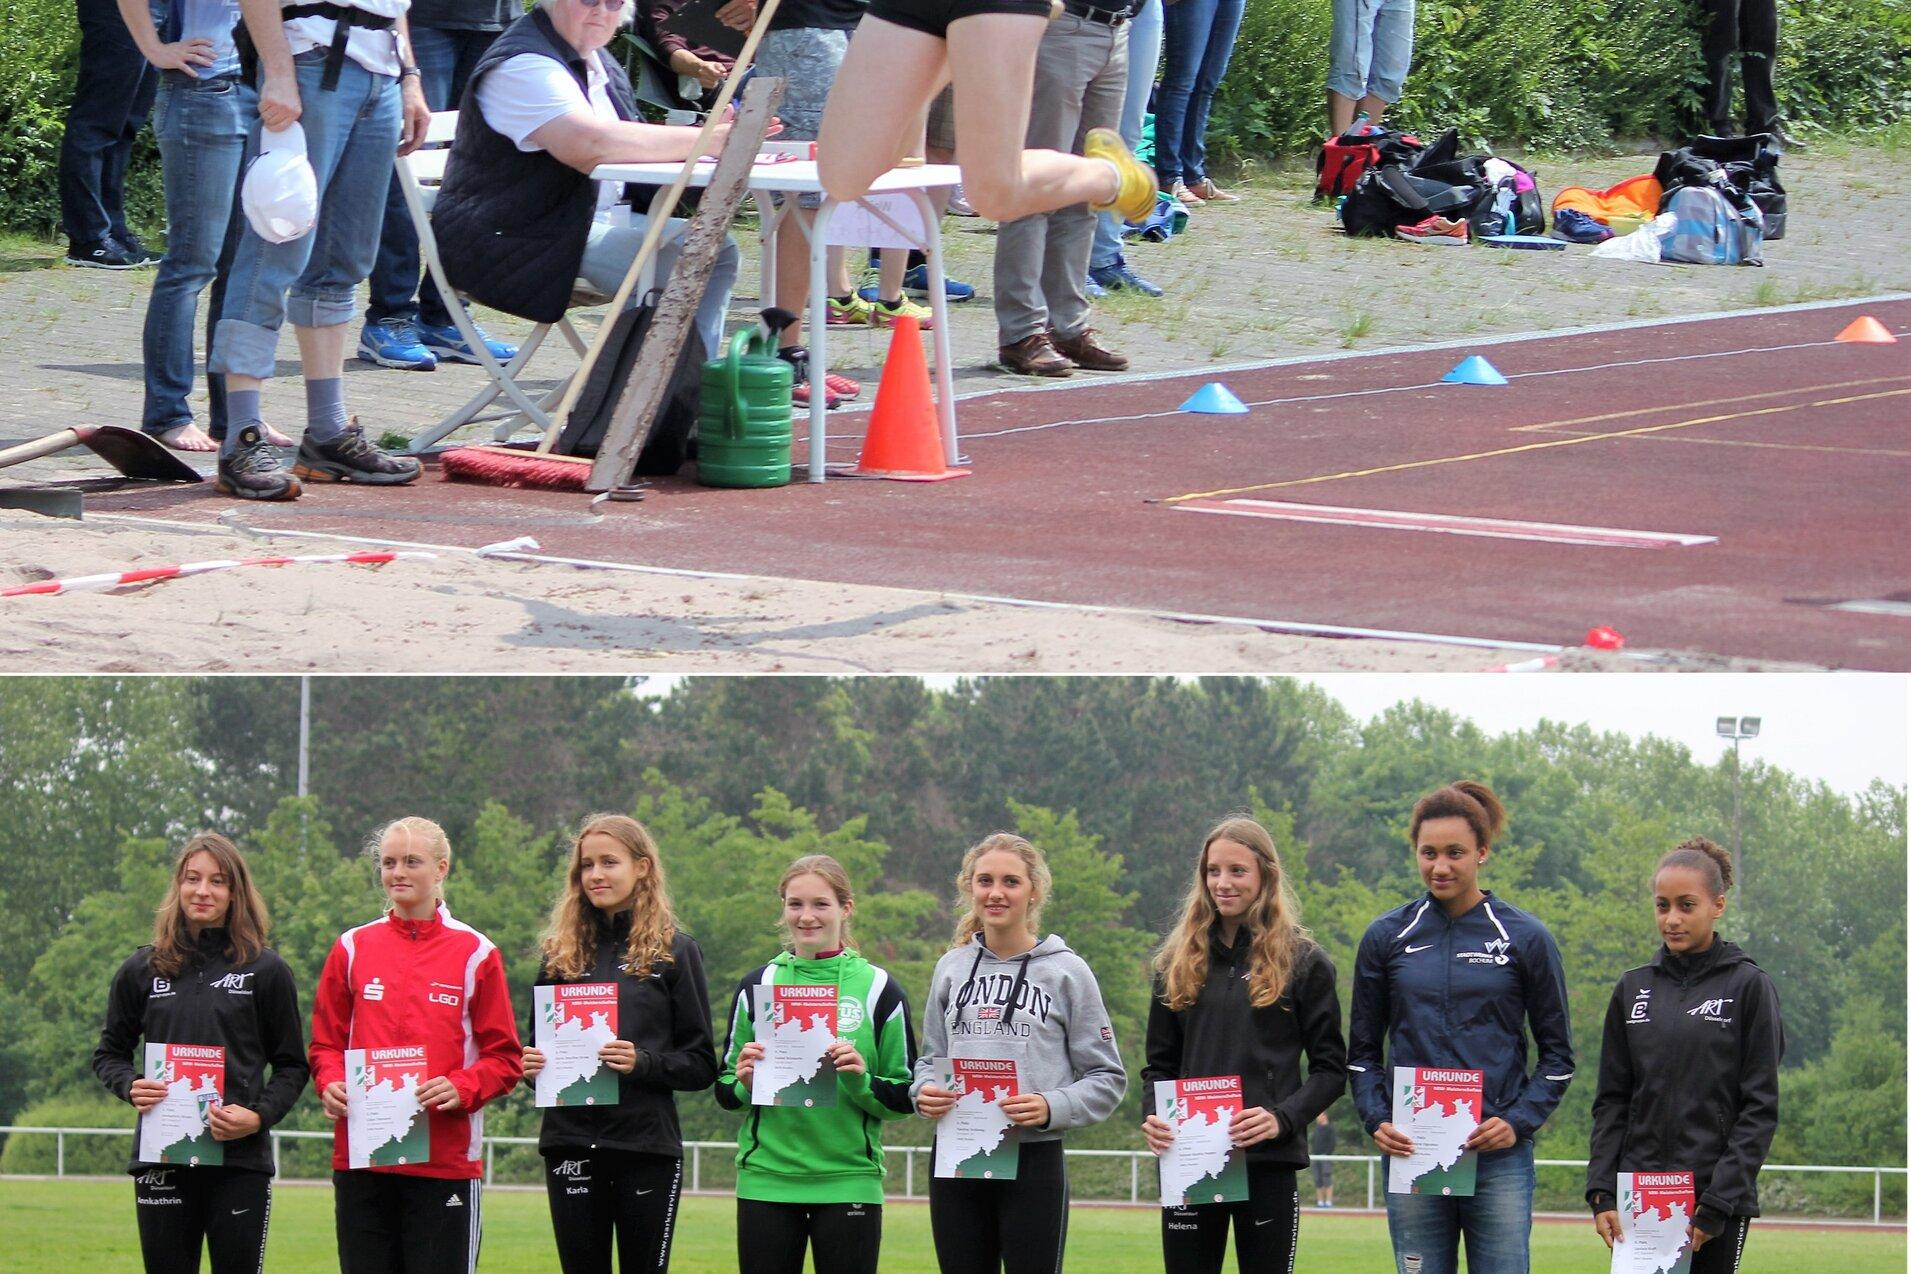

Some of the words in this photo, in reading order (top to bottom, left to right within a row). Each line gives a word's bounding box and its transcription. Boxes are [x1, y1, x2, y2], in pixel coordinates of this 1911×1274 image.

[209, 972, 255, 989] ART
[561, 985, 614, 997] URKUNDE
[780, 987, 835, 997] URKUNDE
[944, 972, 1052, 1025] ONDON
[1686, 998, 1734, 1016] ART
[172, 1046, 222, 1058] URKUNDE
[371, 1047, 424, 1060] URKUNDE
[960, 1060, 1013, 1071] URKUNDE
[1422, 1070, 1480, 1083] URKUNDE
[1182, 1078, 1238, 1092] URKUNDE
[552, 1159, 591, 1176] ART
[1638, 1175, 1690, 1186] URKUNDE
[566, 1186, 589, 1195] Karla
[1168, 1222, 1198, 1230] Helena
